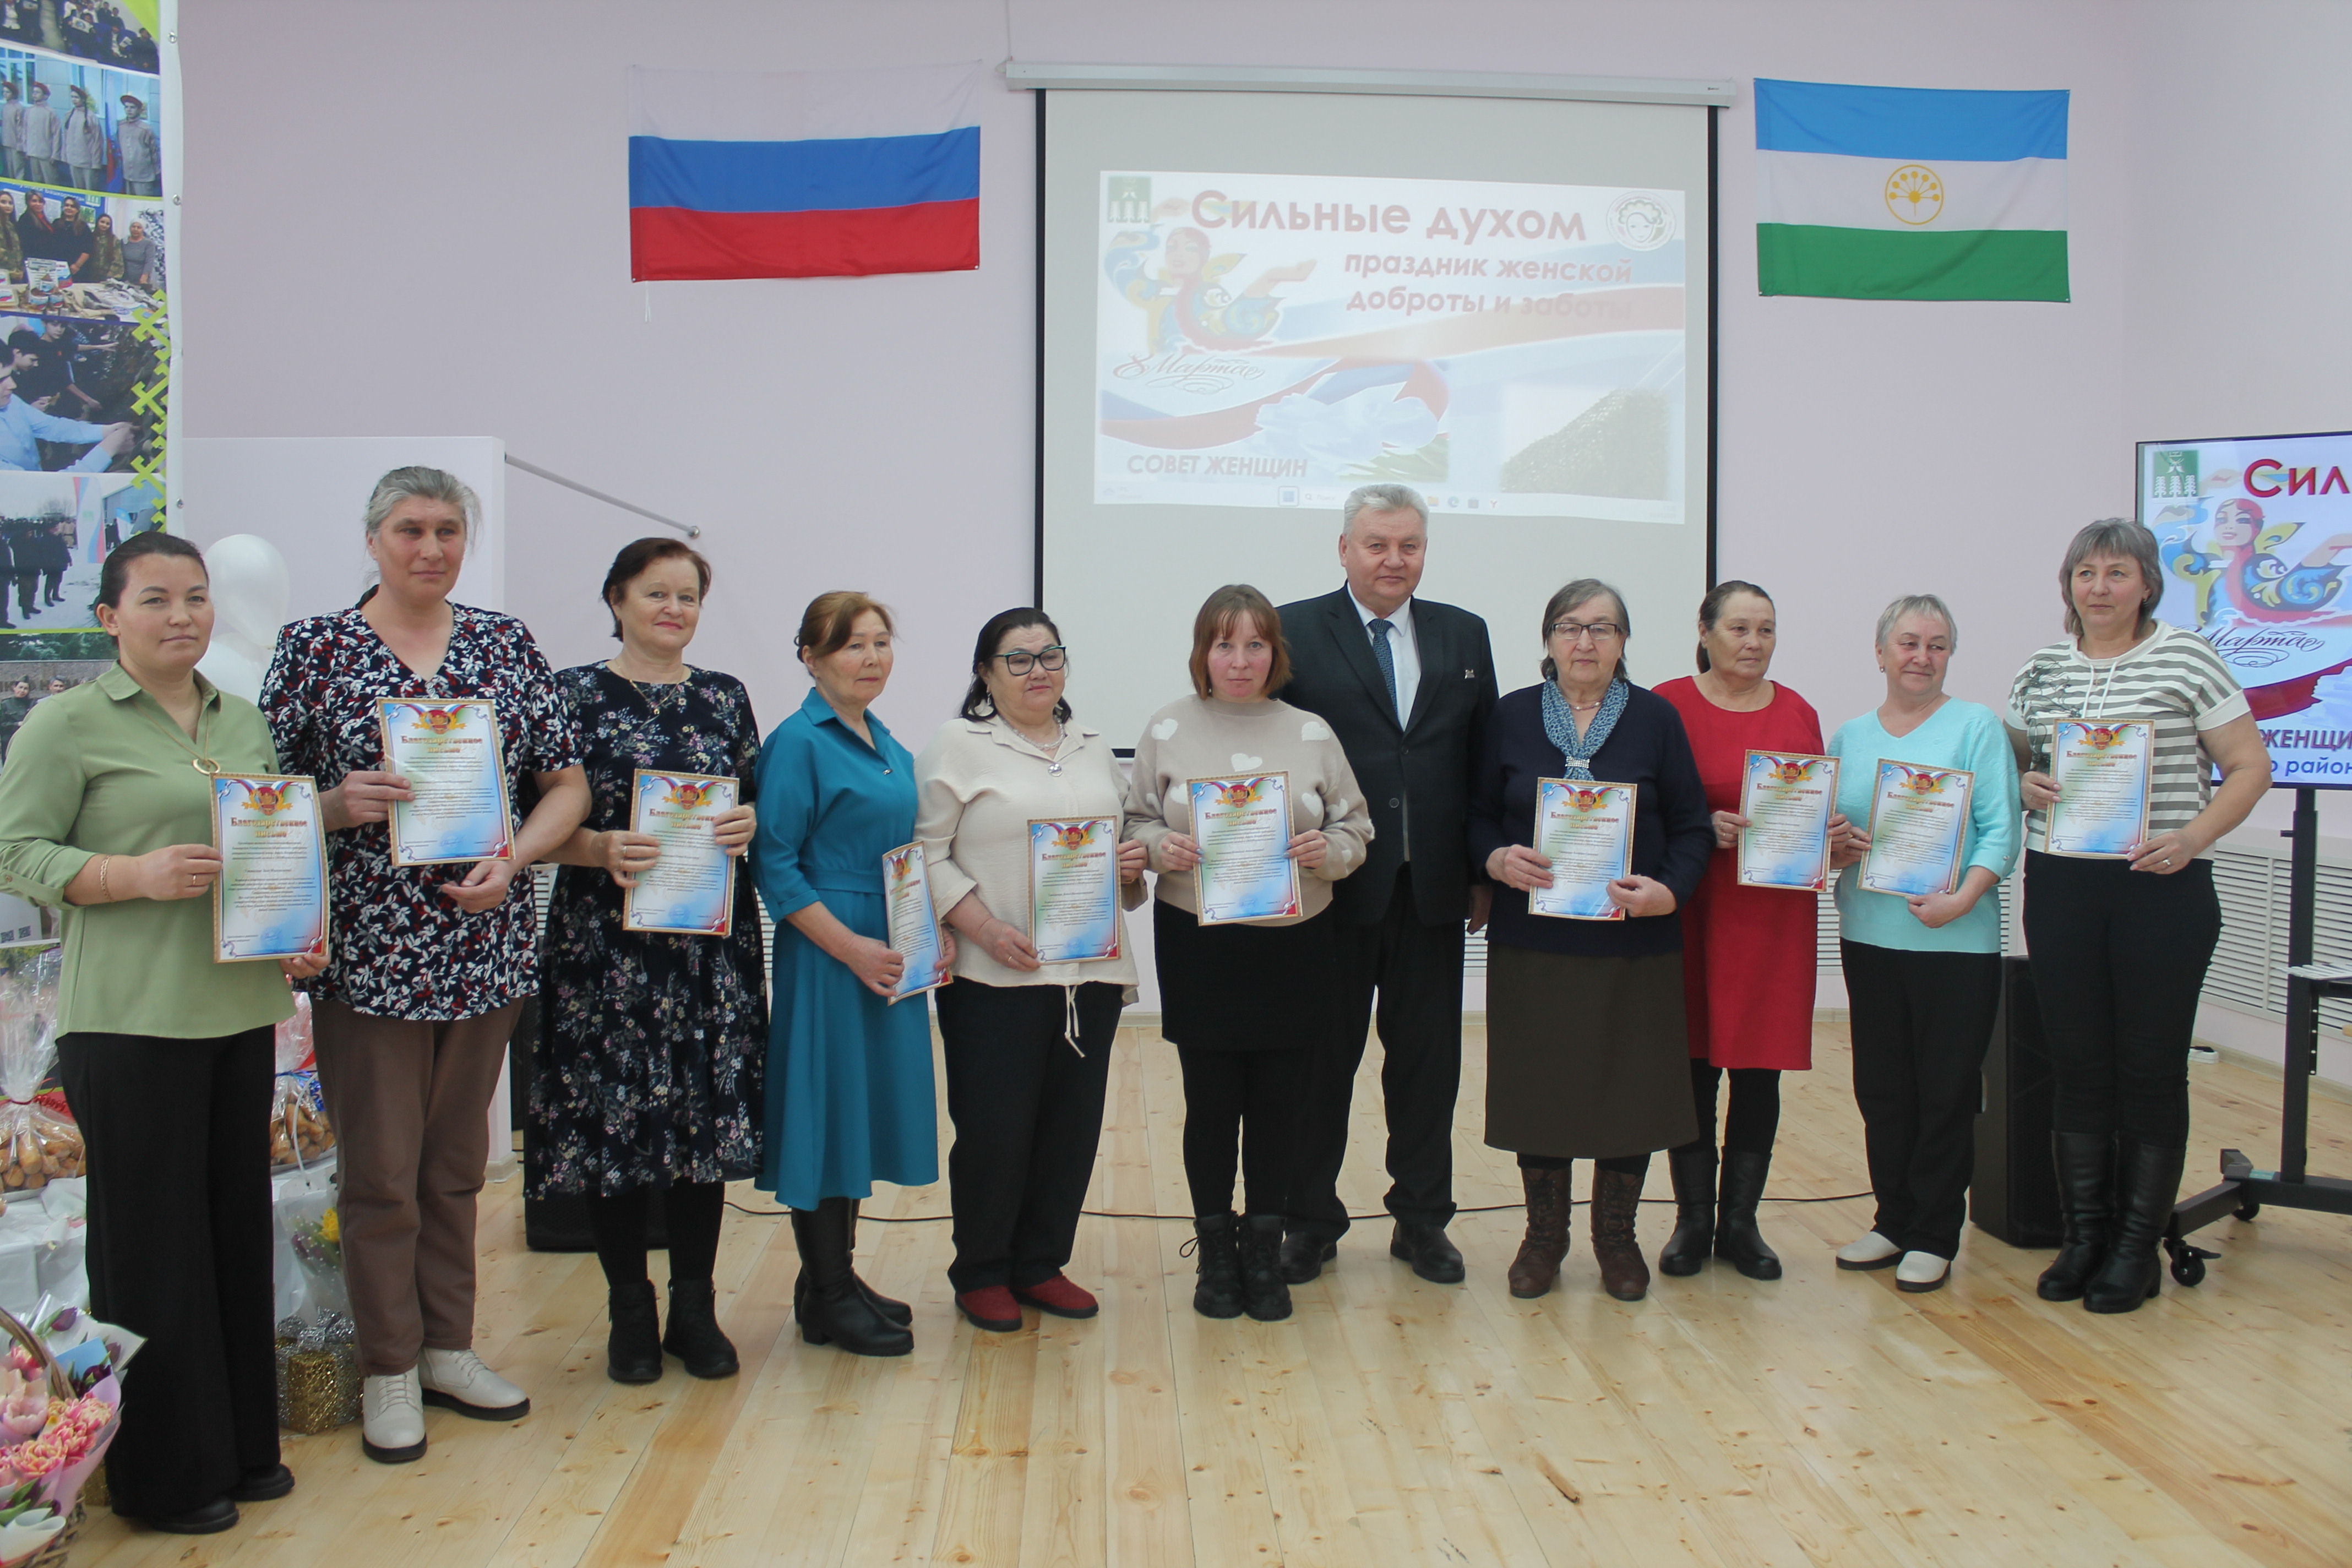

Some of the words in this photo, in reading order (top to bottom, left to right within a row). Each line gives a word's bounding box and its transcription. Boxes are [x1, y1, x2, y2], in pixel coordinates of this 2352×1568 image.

[1191, 189, 1411, 233] Сильные
[1425, 207, 1587, 245] духом
[1344, 253, 1489, 277] праздник
[1495, 258, 1632, 284] женской
[1346, 286, 1485, 316] доброты
[1494, 296, 1511, 313] и
[1520, 293, 1632, 320] заботы
[1128, 454, 1201, 474] СОВЕТ
[1204, 456, 1308, 478] ЖЕНЩИН
